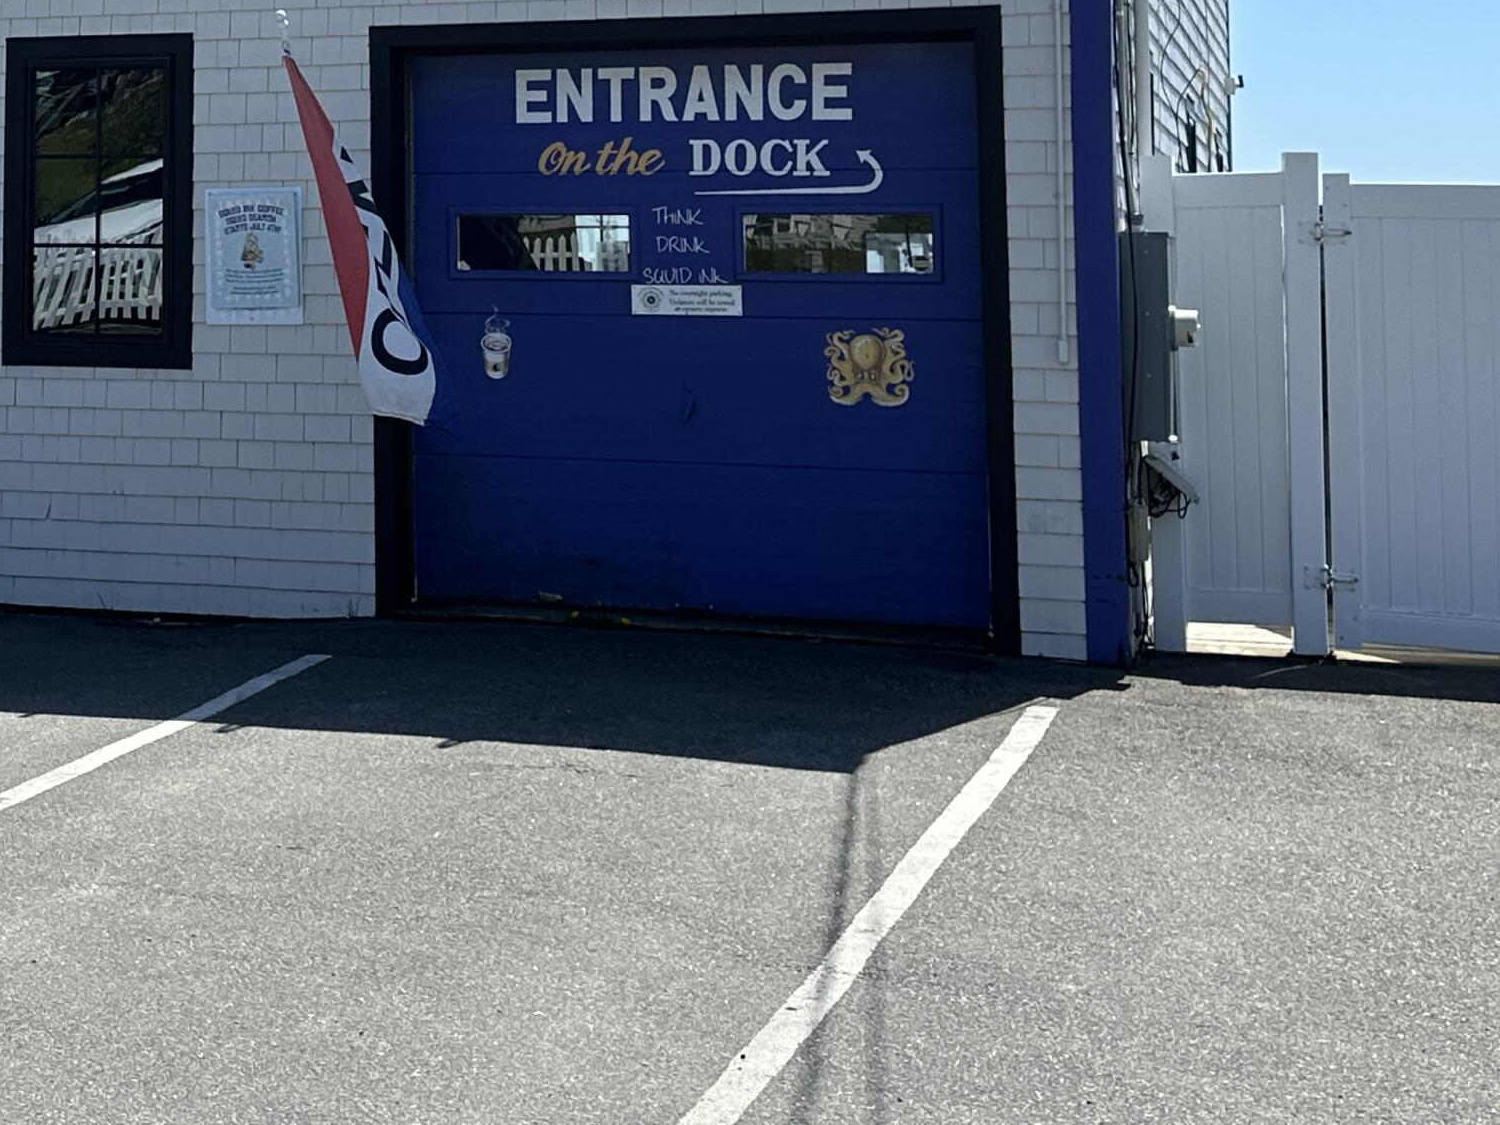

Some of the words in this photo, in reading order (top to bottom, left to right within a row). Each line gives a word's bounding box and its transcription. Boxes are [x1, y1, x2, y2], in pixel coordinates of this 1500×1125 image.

[515, 62, 853, 124] ENTRANCE
[538, 140, 591, 176] On
[595, 136, 665, 176] the
[688, 138, 831, 176] DOCK
[643, 267, 692, 284] SQUID
